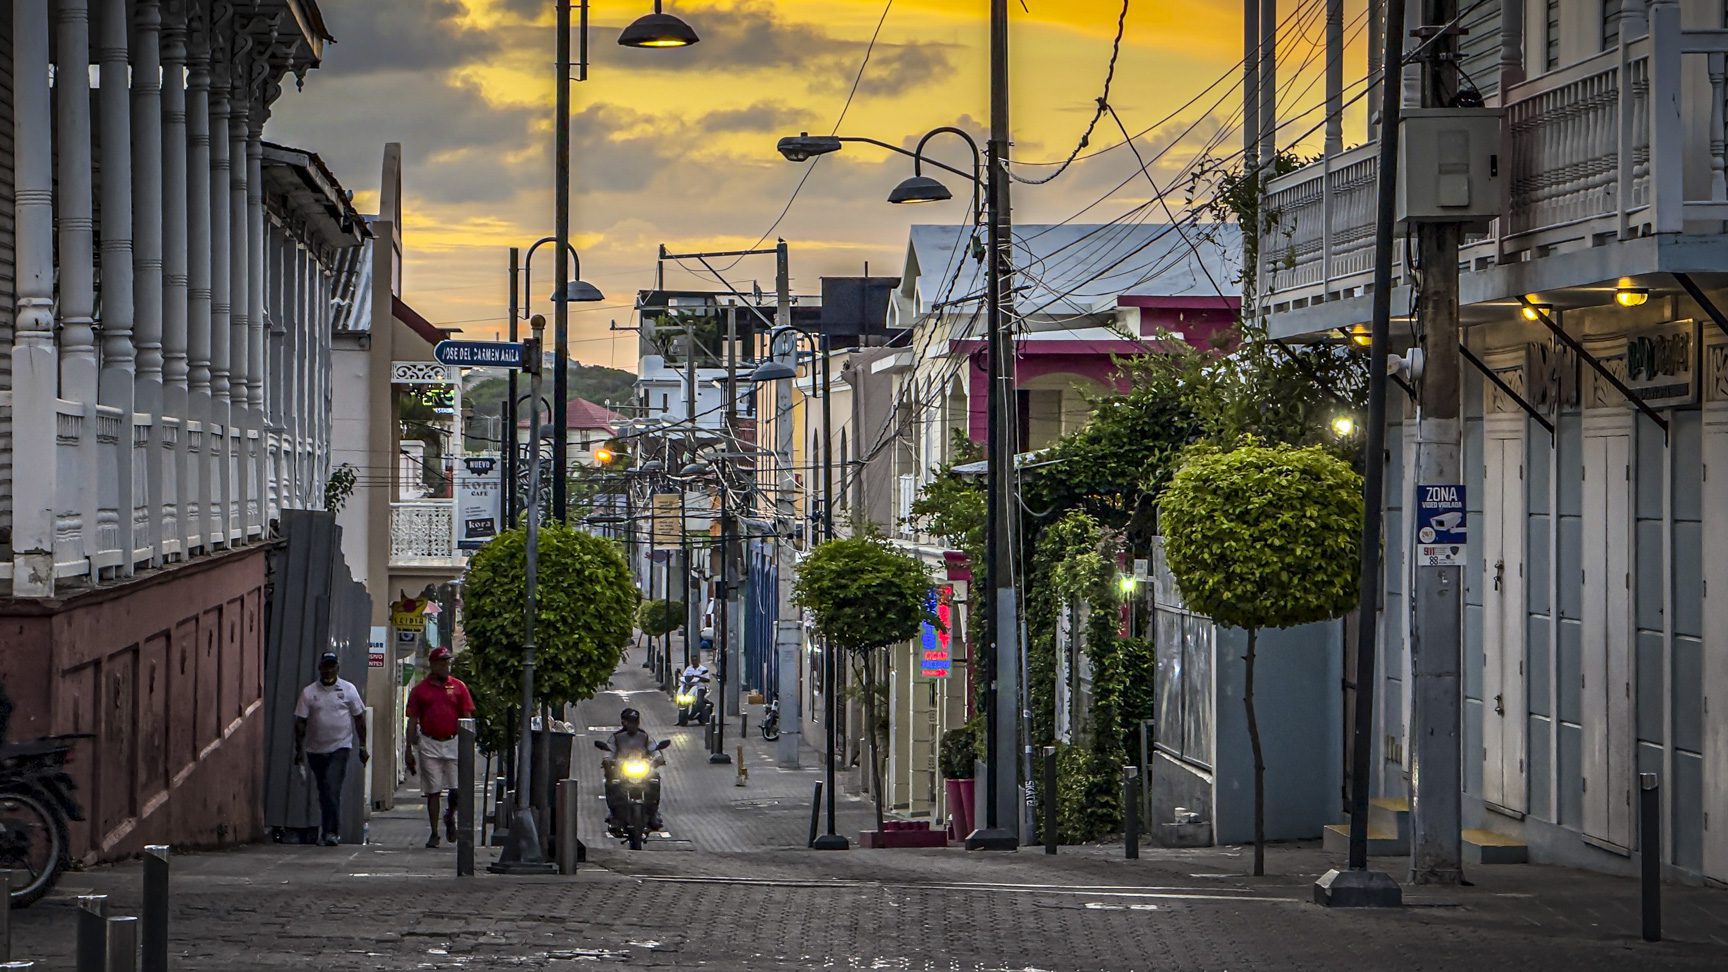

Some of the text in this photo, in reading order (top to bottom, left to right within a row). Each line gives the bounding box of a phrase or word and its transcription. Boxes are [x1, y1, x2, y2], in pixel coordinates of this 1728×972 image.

[442, 347, 458, 360] JOSE
[459, 348, 471, 360] DEL
[469, 461, 490, 469] NUEVO
[462, 478, 498, 490] kora
[1426, 487, 1457, 502] ZONA
[1422, 501, 1463, 509] VIDEO VIGILADA
[468, 521, 491, 529] kora
[1423, 547, 1435, 556] 911
